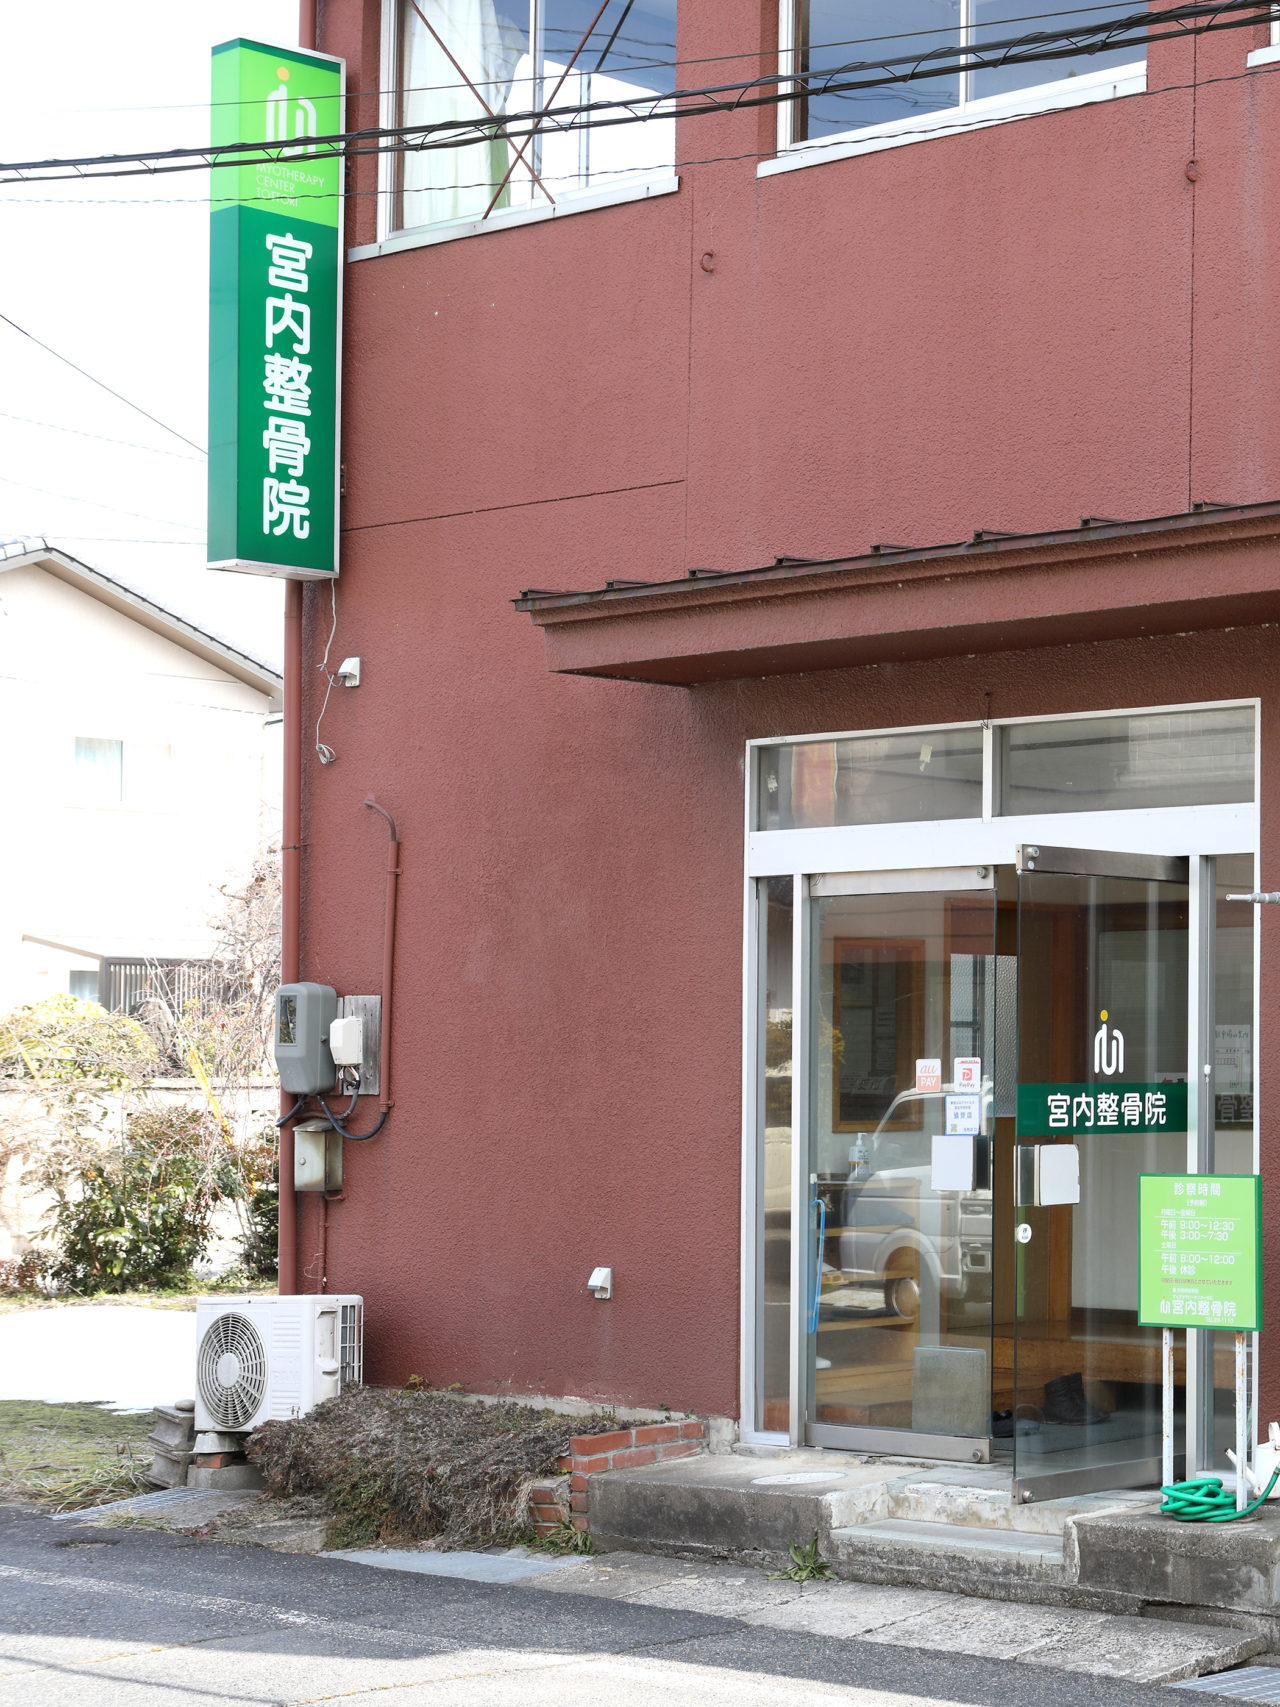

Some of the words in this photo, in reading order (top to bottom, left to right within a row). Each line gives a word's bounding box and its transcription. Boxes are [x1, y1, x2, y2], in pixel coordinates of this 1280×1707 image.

[256, 163, 324, 188] MYOTHERAPY
[256, 174, 295, 193] CENTER
[256, 187, 298, 208] TOTTORI
[262, 232, 313, 539] 宮内整骨院
[920, 1064, 937, 1074] au
[920, 1077, 936, 1087] PAY
[1047, 1091, 1167, 1127] 宮内整骨院
[1160, 1219, 1177, 1230] 午前
[1160, 1230, 1177, 1240] 午後
[1161, 1253, 1177, 1263] 午前
[1161, 1264, 1177, 1274] 午後
[1180, 1265, 1196, 1275] 休診
[1172, 1299, 1237, 1317] 宮内整骨院
